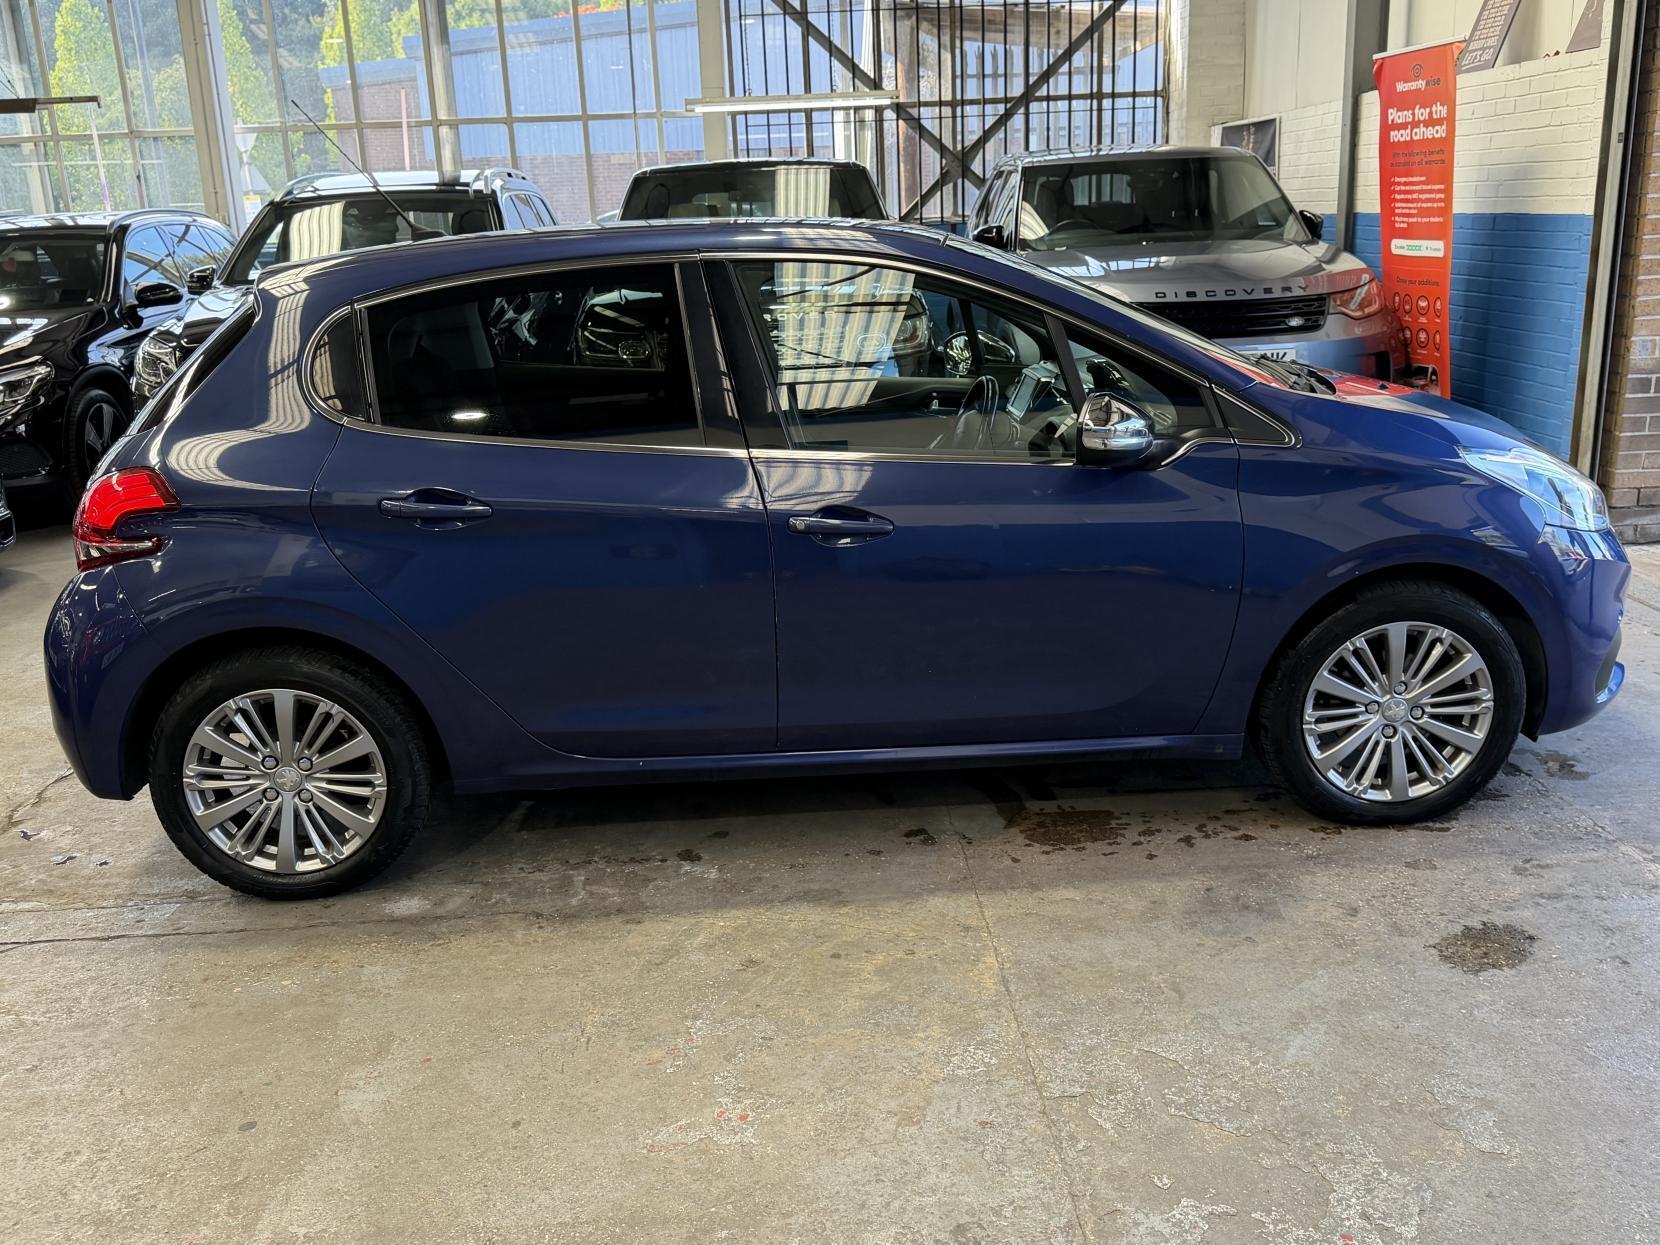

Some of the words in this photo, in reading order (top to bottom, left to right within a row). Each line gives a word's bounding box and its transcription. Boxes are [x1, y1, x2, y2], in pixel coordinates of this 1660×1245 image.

[1396, 78, 1441, 92] Warrantywise
[1387, 106, 1413, 125] Plans
[1414, 104, 1430, 121] for
[1431, 101, 1448, 119] the
[1389, 124, 1411, 143] road
[1412, 120, 1447, 141] ahead
[1155, 284, 1309, 299] DISCOVERY
